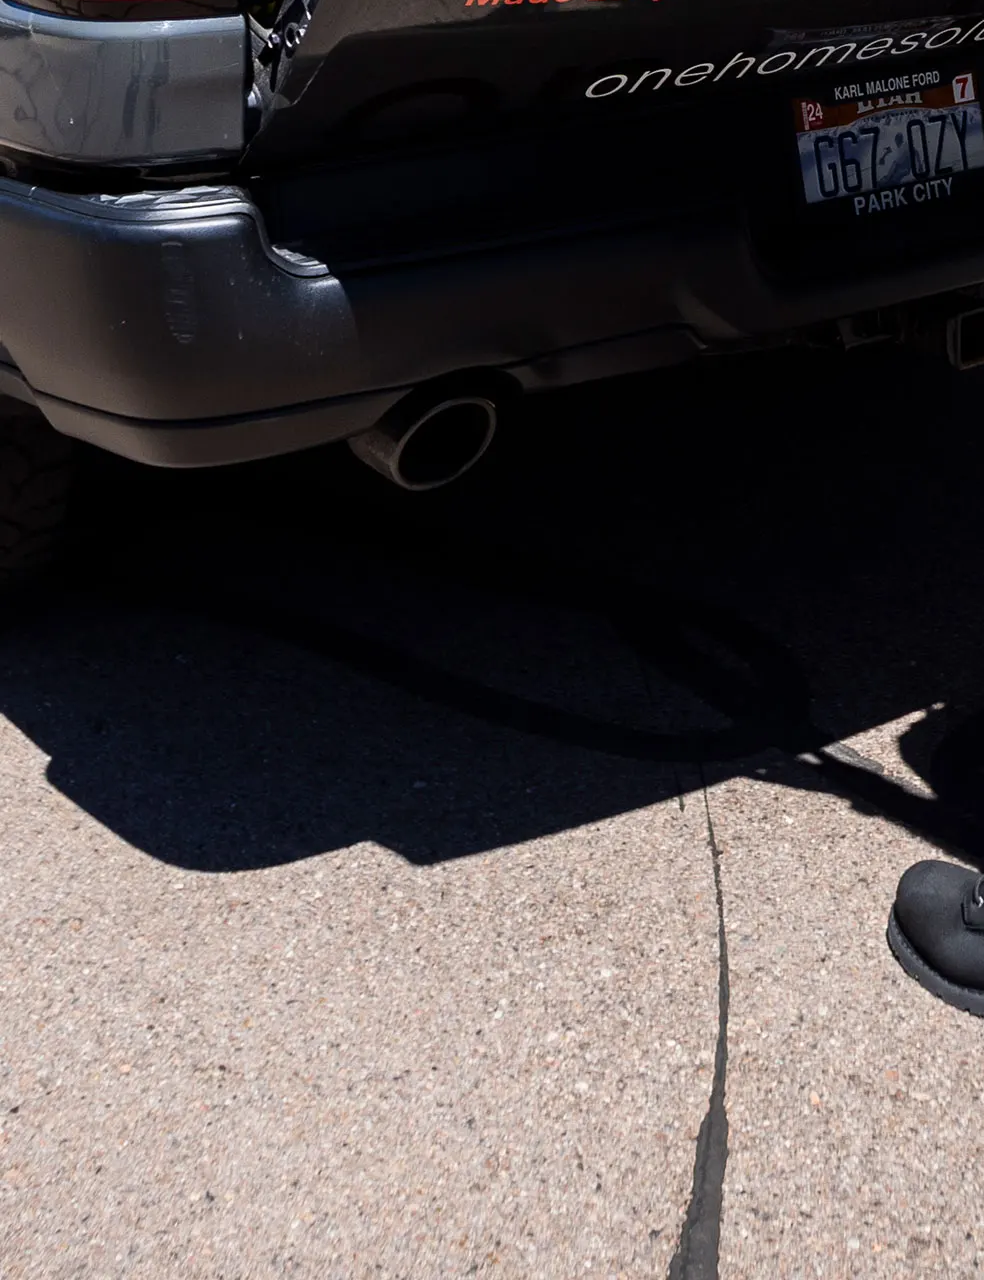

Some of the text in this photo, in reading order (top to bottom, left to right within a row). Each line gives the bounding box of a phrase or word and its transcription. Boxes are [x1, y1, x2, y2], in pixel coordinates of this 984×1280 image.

[834, 71, 940, 100] KARL MALONE FORD
[955, 77, 969, 99] 7
[807, 102, 823, 122] 24
[813, 127, 880, 198] G67
[854, 177, 953, 215] PARK CITY
